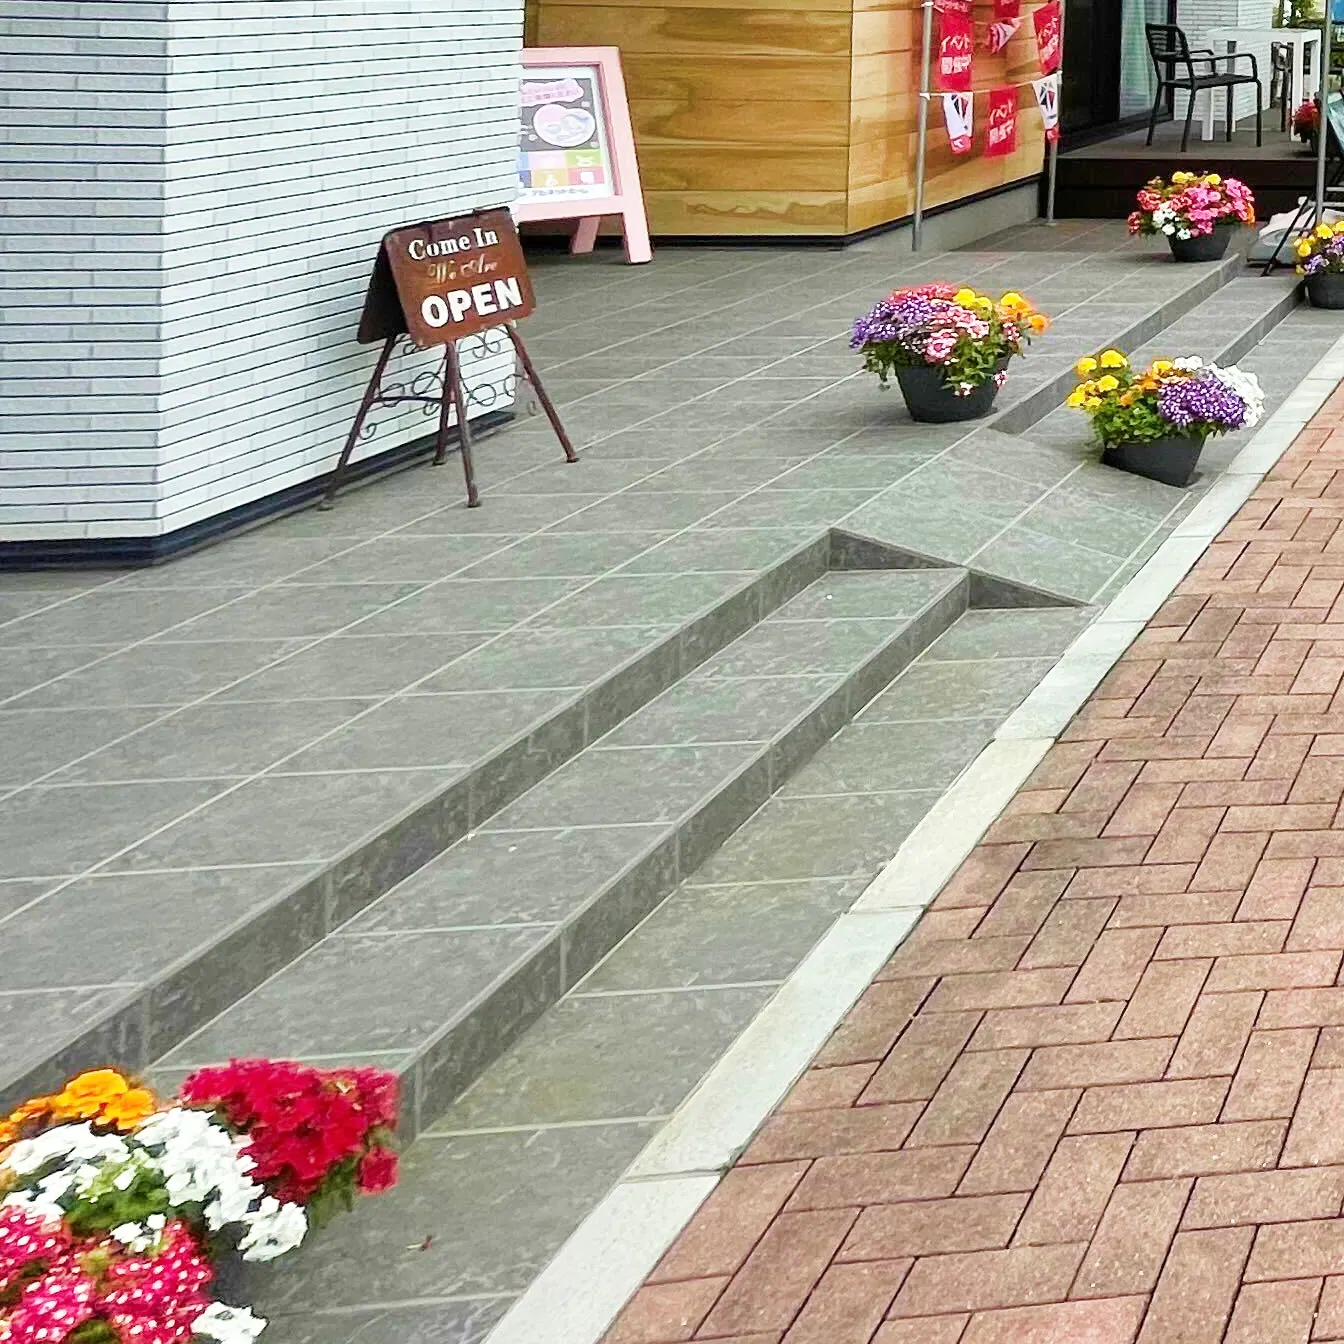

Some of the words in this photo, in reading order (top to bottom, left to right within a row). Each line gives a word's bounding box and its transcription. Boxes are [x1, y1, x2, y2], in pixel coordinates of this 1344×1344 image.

[408, 235, 471, 261] Come
[473, 227, 499, 248] In
[421, 276, 523, 328] OPEN
